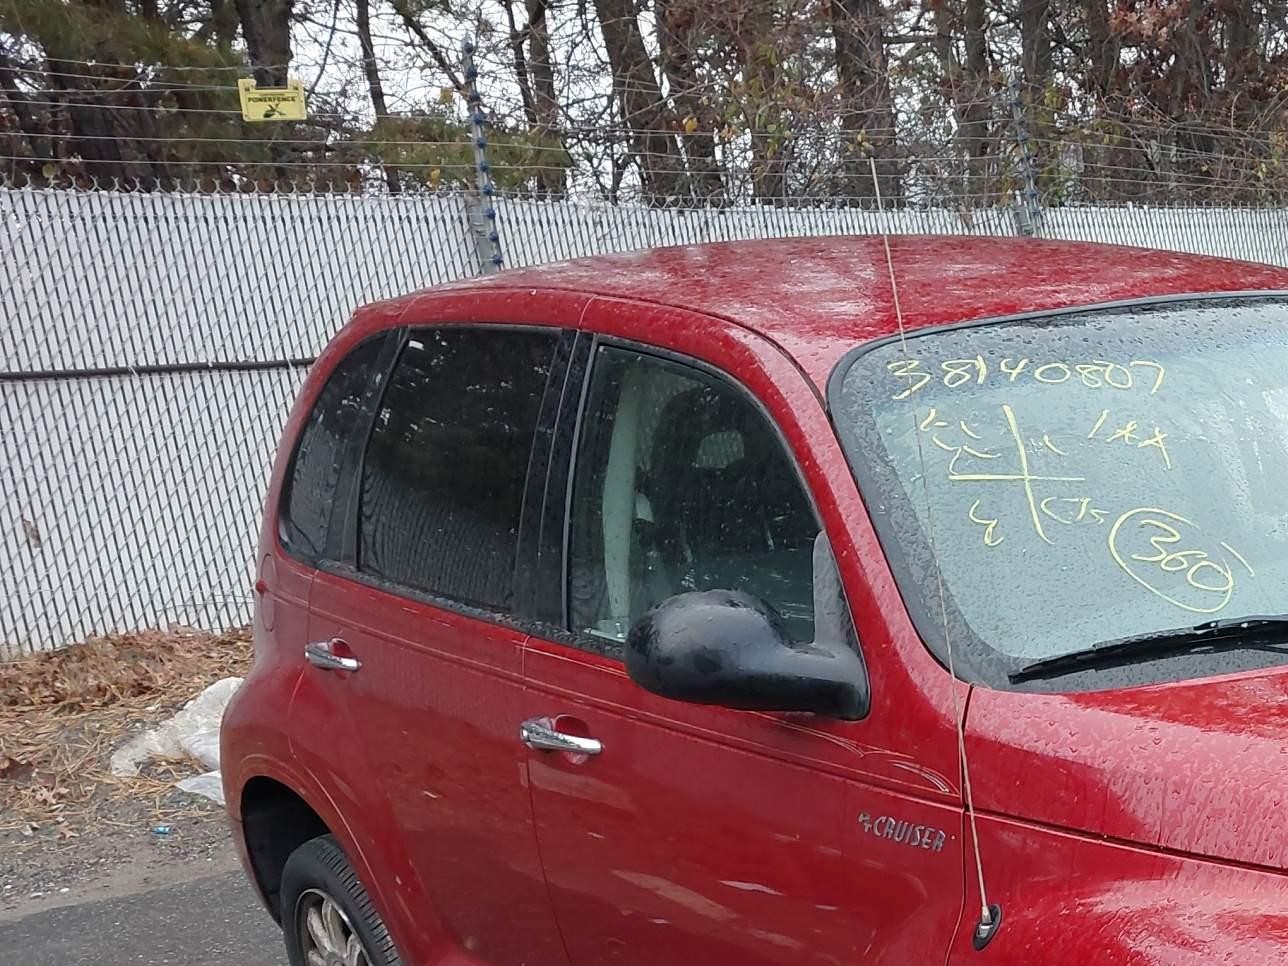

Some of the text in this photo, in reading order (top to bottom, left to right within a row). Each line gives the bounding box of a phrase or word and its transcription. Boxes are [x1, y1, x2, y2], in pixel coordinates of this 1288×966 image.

[887, 354, 1165, 399] 38140807
[1132, 519, 1234, 592] 360
[873, 815, 947, 852] CRUISER
